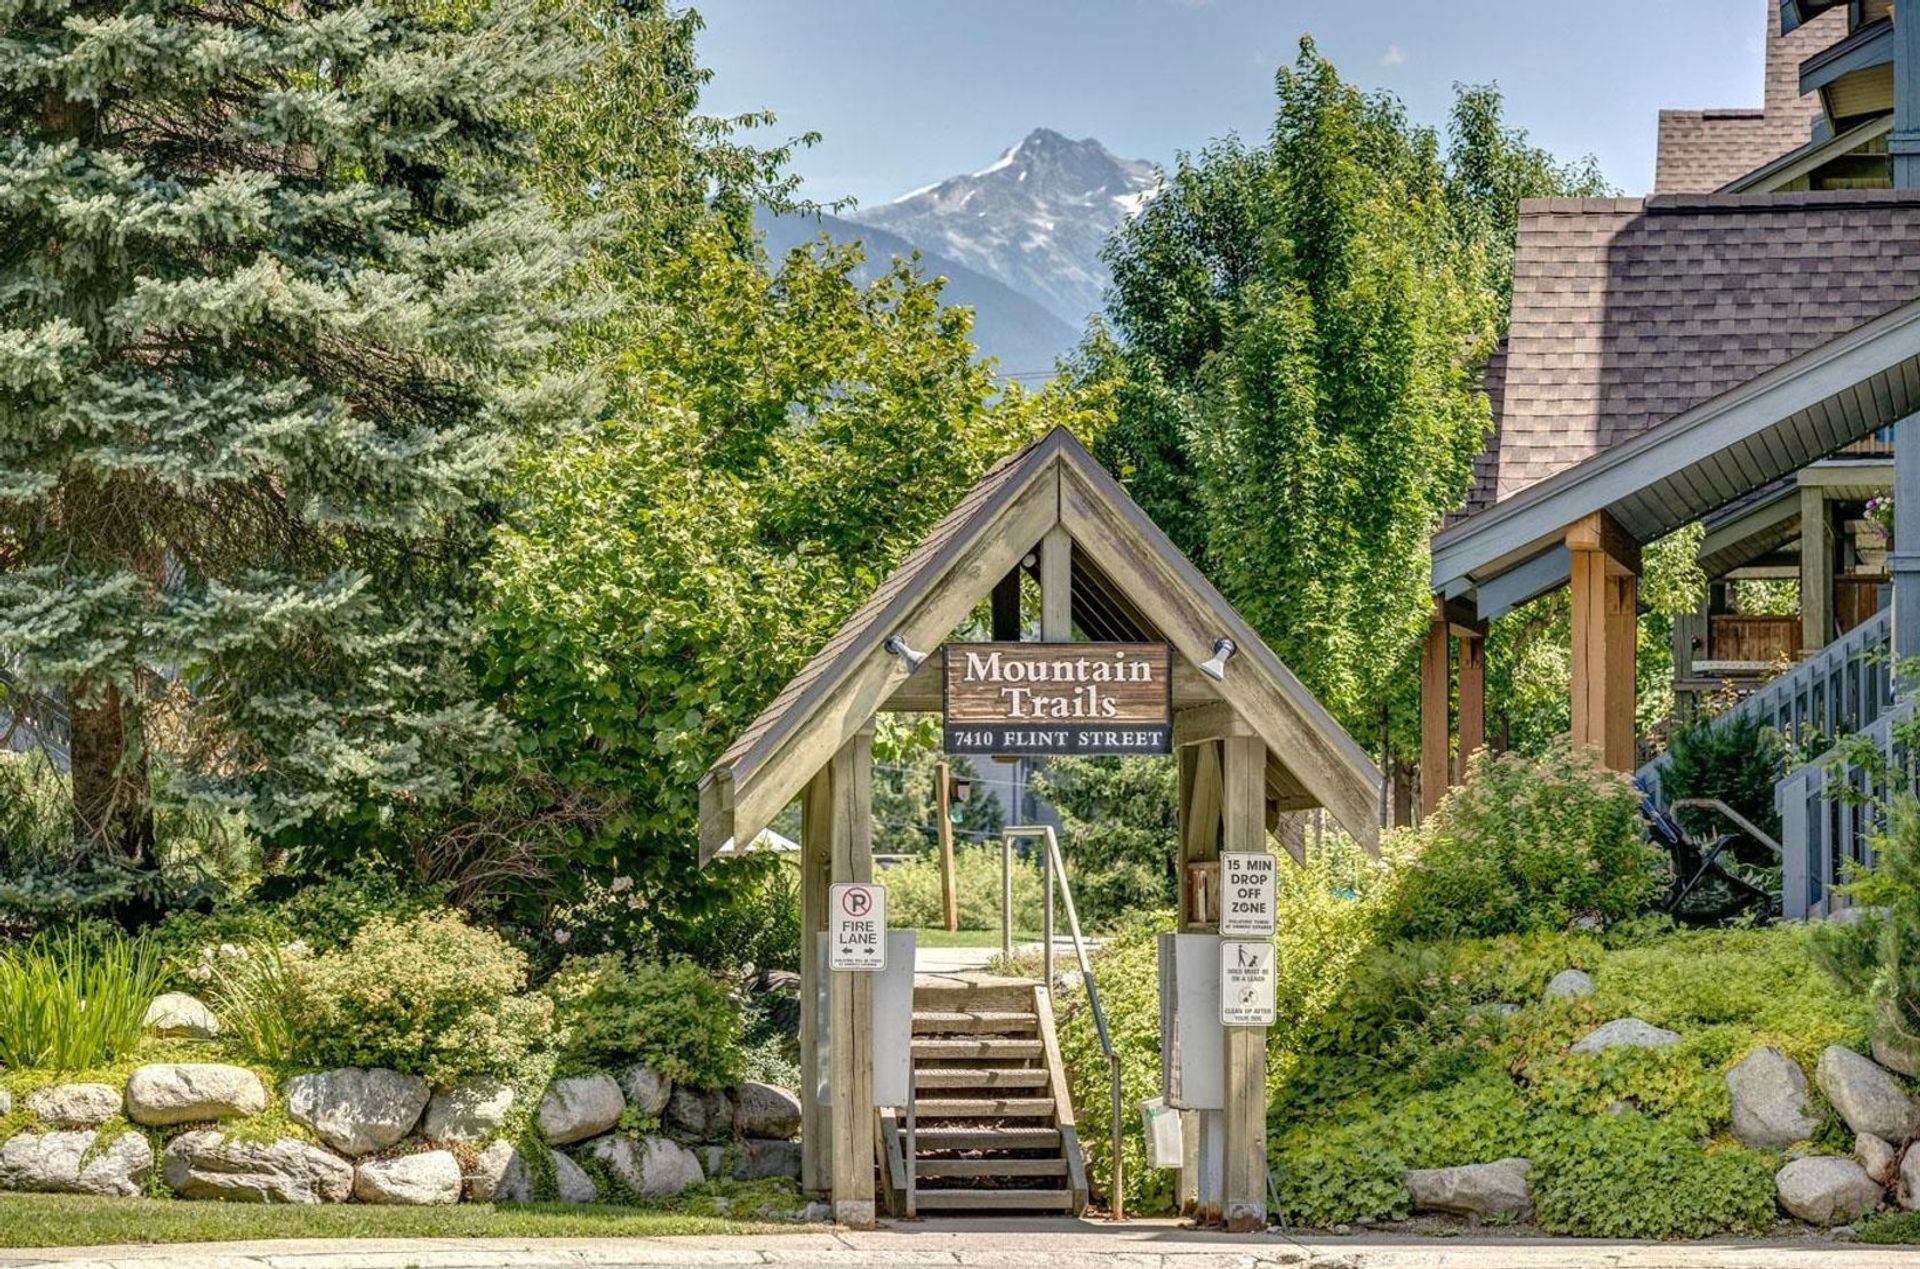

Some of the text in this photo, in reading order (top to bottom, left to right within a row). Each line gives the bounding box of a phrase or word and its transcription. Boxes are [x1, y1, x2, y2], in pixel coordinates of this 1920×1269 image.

[963, 651, 1152, 682] Mountain
[1001, 685, 1117, 718] Trails
[955, 731, 1163, 746] 7410 FLINT STREET
[1227, 860, 1272, 871] 15 MIN
[1231, 874, 1268, 885] DROP
[1237, 888, 1261, 899] OFF
[1231, 902, 1266, 913] ZONE
[842, 921, 874, 932] FIRE
[839, 933, 877, 944] LANE
